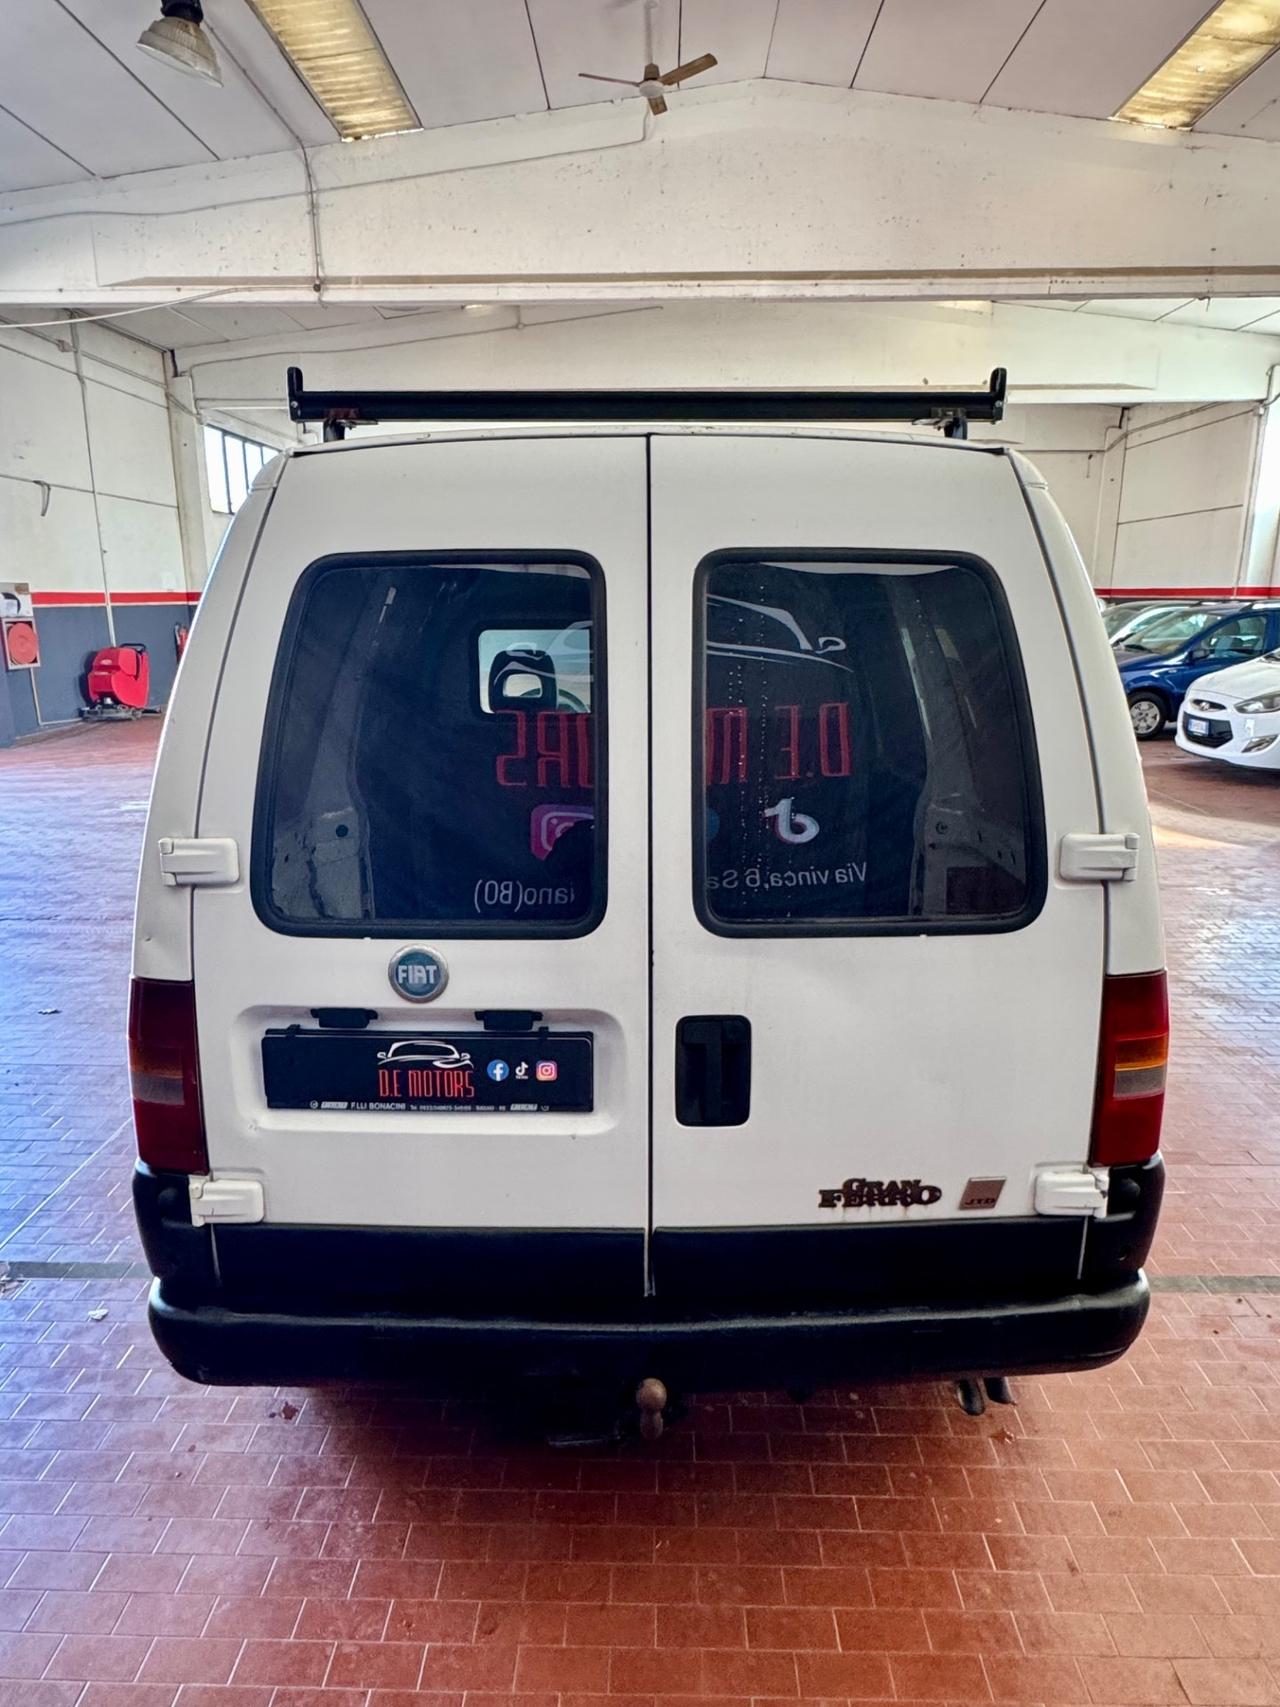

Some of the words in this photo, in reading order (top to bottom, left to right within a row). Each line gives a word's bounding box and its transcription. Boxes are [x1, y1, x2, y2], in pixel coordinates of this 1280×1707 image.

[397, 964, 438, 985] FIAT
[378, 1069, 402, 1098] D.E
[408, 1069, 475, 1098] MOTORS
